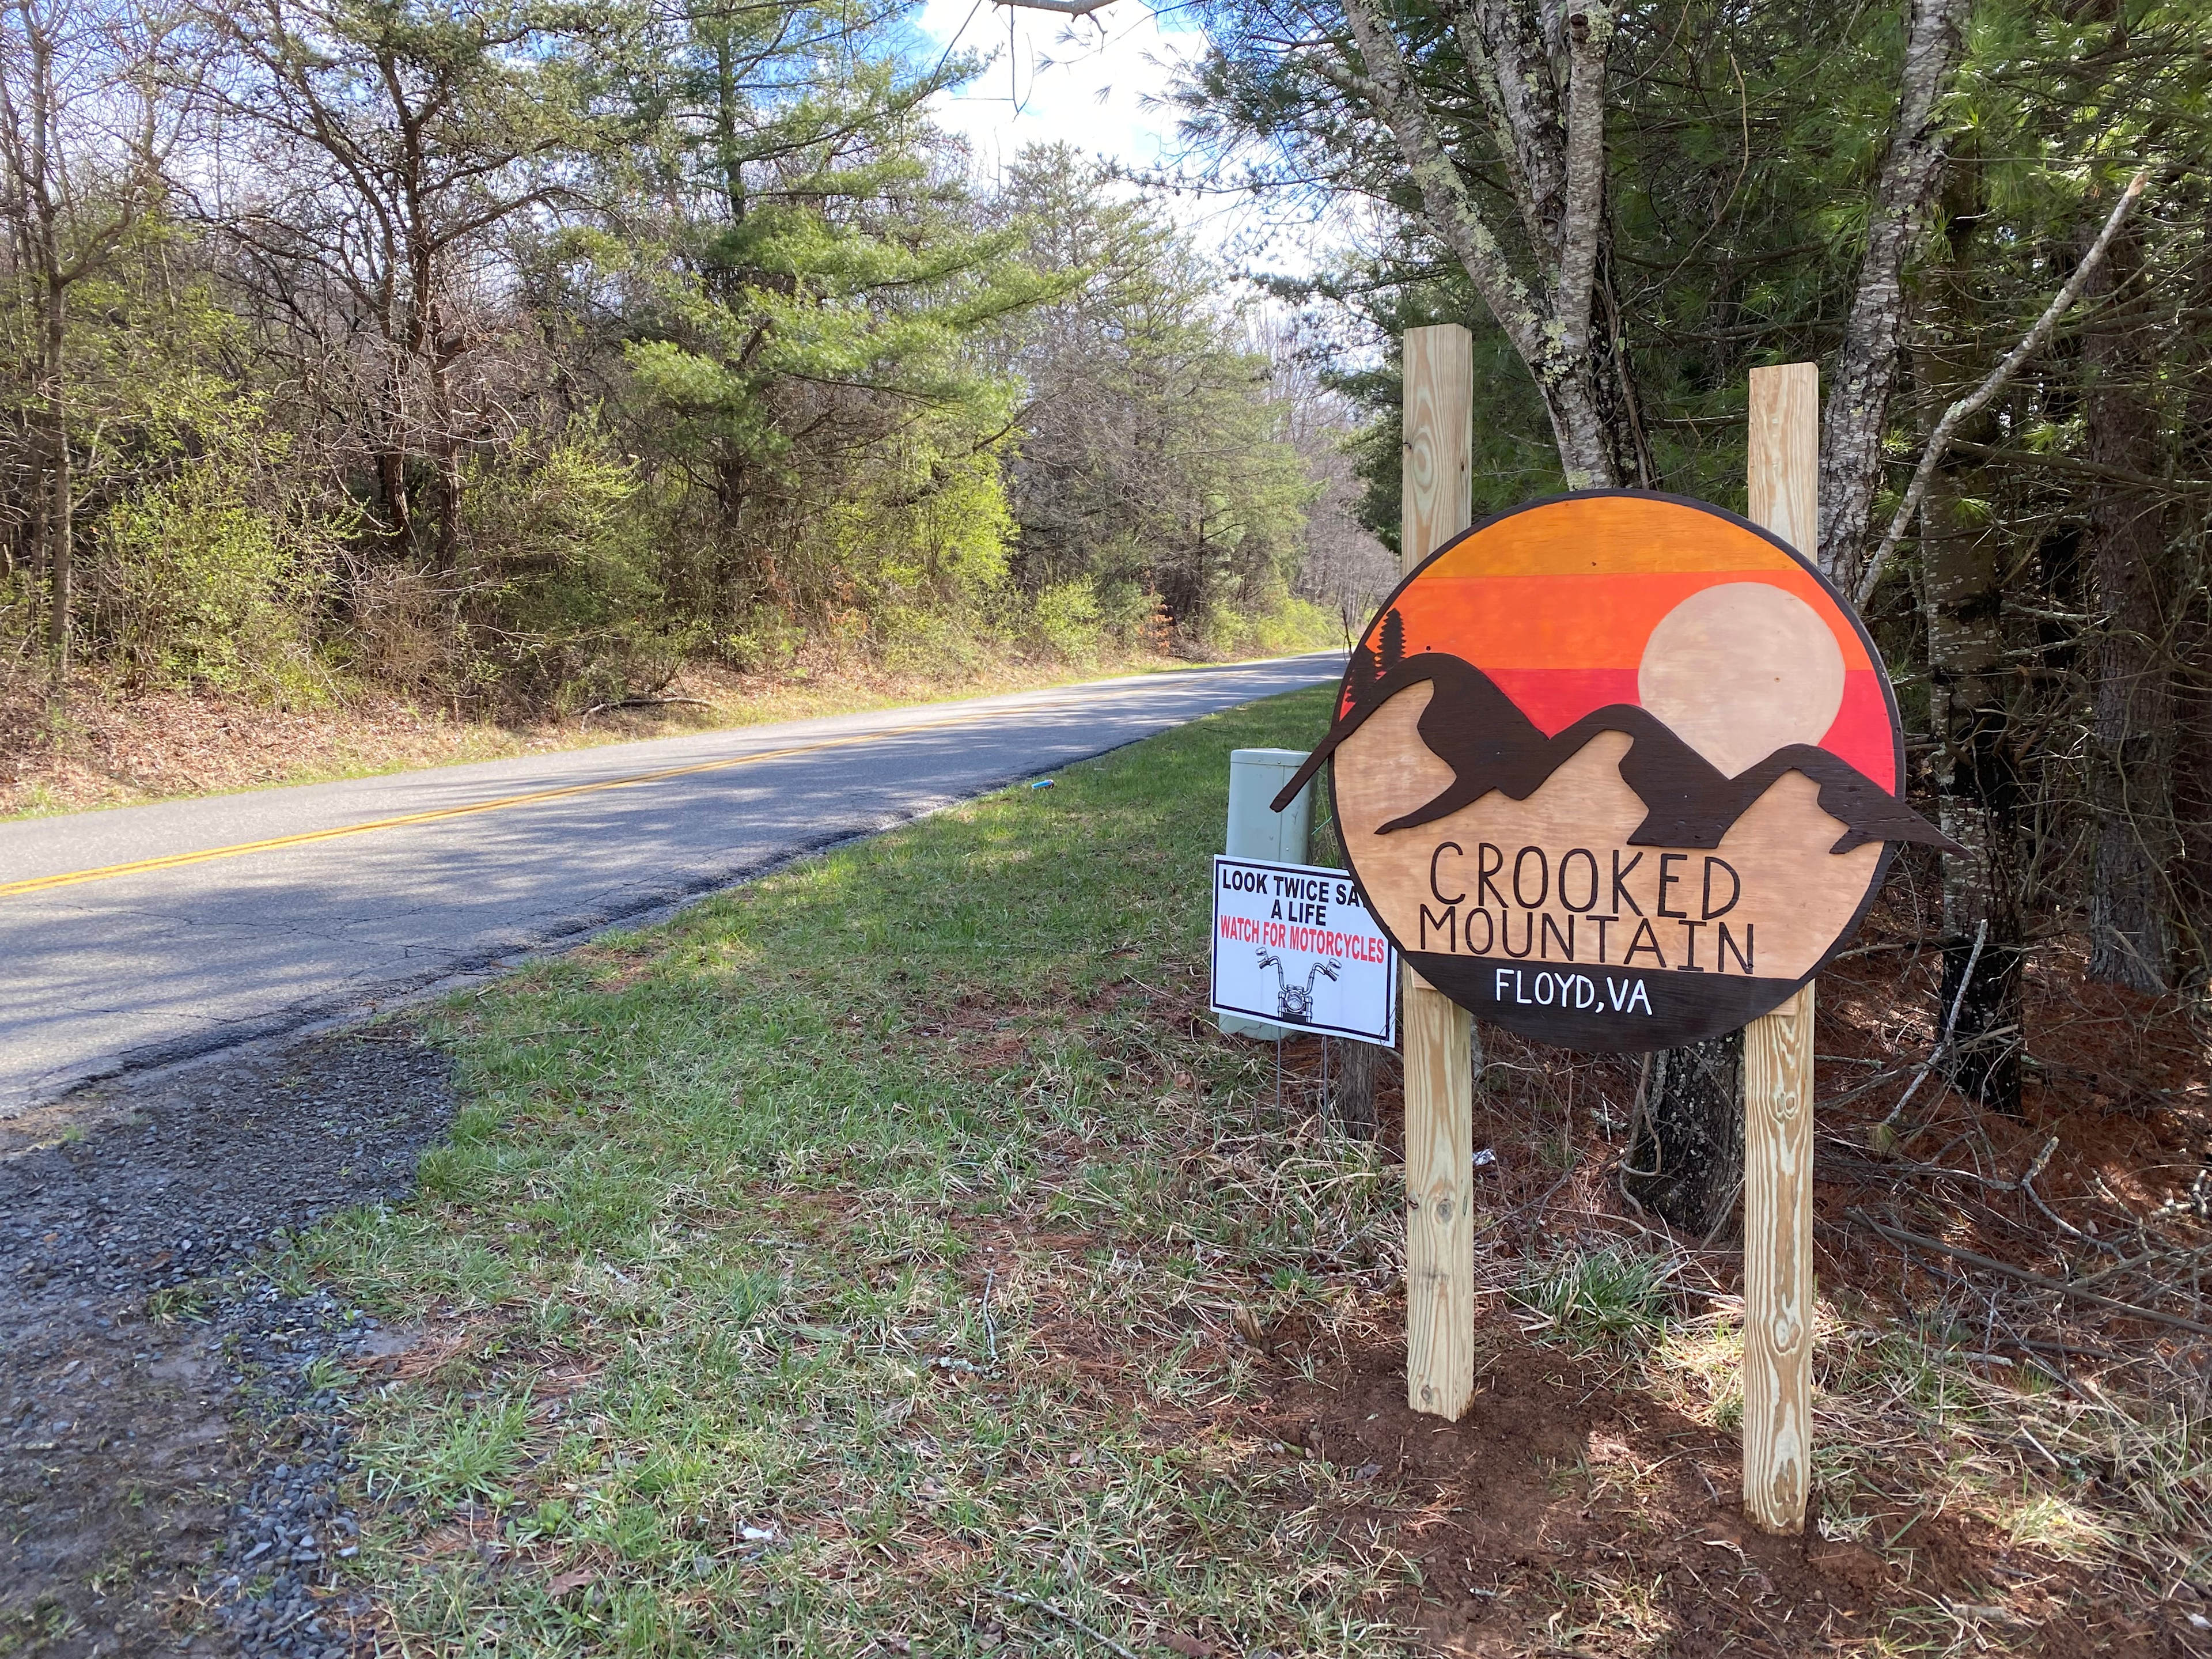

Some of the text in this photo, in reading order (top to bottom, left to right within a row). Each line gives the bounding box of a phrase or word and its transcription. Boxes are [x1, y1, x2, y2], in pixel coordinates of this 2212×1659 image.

[1222, 869, 1268, 895] LOOK
[1274, 875, 1329, 903] TWICE
[1430, 841, 1740, 921] CROOKED
[1271, 899, 1327, 926] A LIFE
[1220, 914, 1384, 964] WATCH FOR MOTORCYCLES
[1419, 903, 1754, 975] MOUNTAIN
